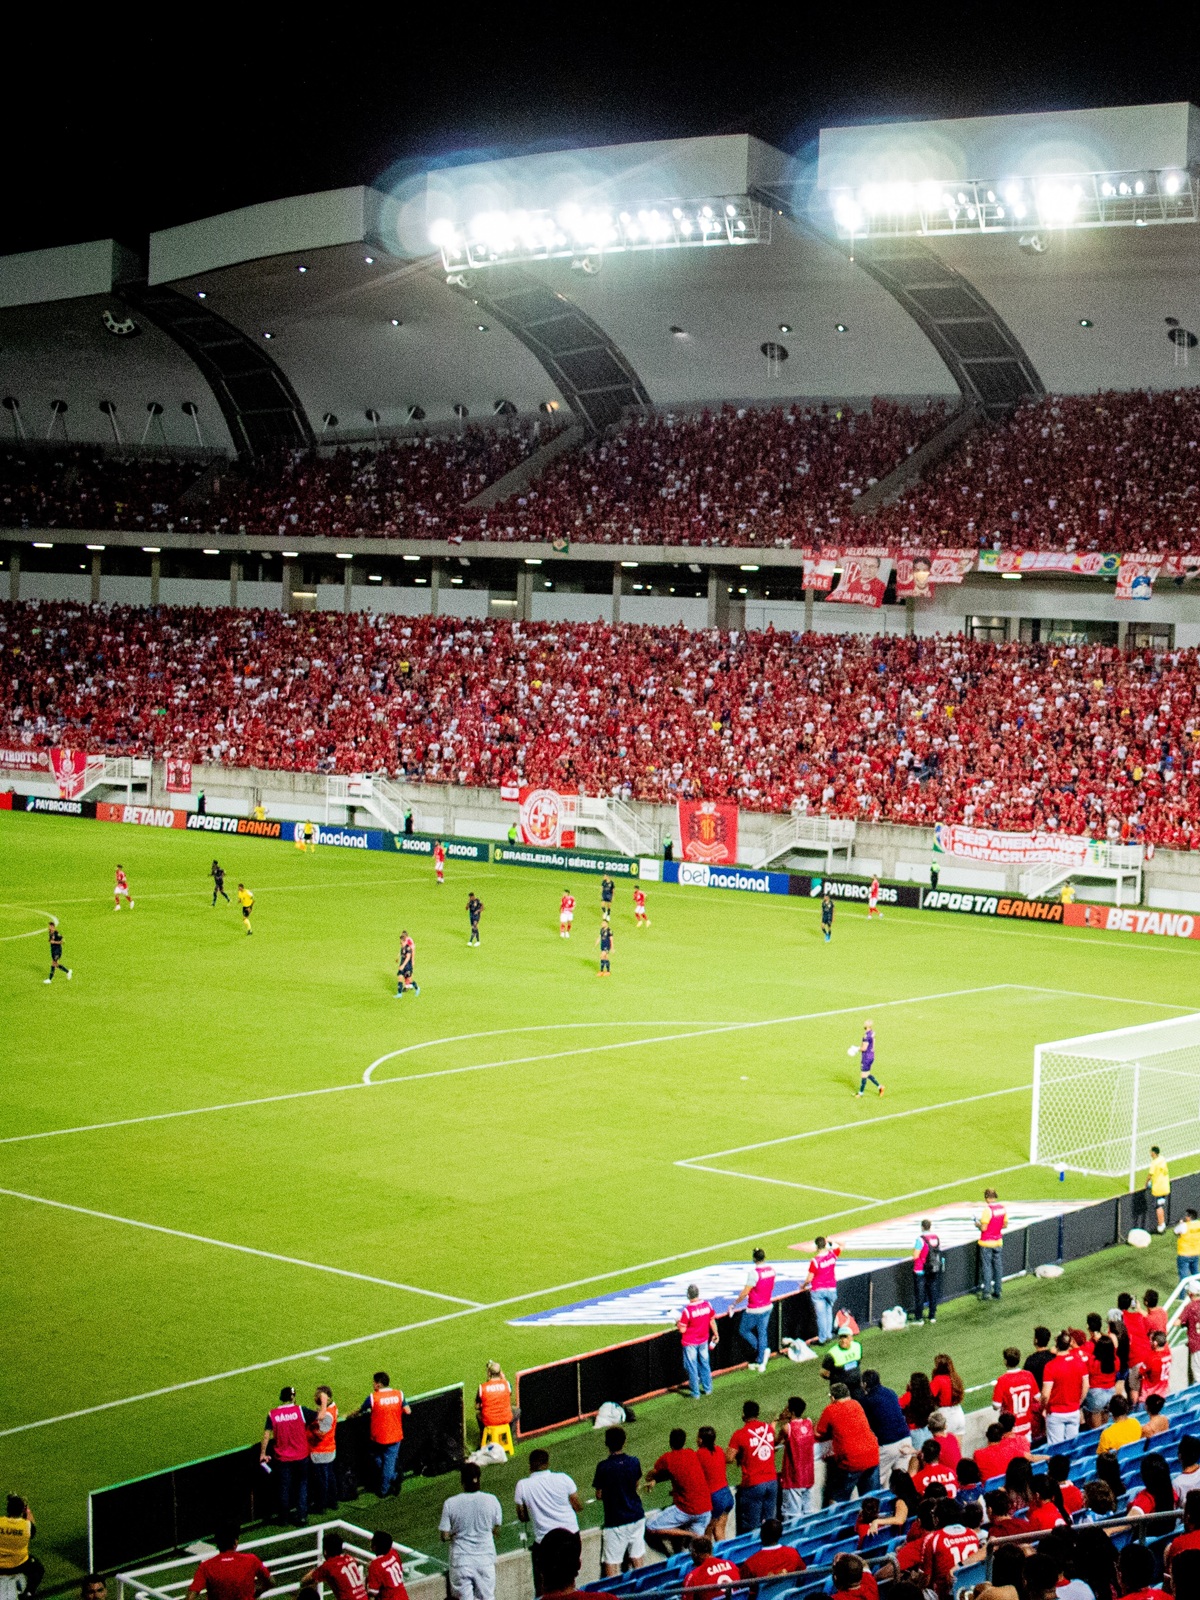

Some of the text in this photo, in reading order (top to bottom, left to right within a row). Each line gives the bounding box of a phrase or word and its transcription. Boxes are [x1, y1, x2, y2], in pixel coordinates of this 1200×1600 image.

[35, 798, 82, 814] PAYBROKERS
[121, 806, 175, 828] BETANO
[402, 838, 431, 852] SICOOB
[449, 844, 478, 858] SICOOB
[502, 850, 564, 867] BRASILEIRÃO
[568, 854, 596, 869] SÉRIE
[605, 861, 630, 873] 2023
[824, 882, 898, 902] PAYBROERS
[1106, 908, 1194, 938] BETANO
[380, 1396, 399, 1406] FOTO
[1011, 1391, 1031, 1414] 10
[274, 1412, 298, 1423] RÁDIO
[922, 1472, 956, 1487] CAIXA
[341, 1561, 364, 1588] 10
[386, 1561, 404, 1587] 10
[706, 1561, 733, 1576] CAIXA
